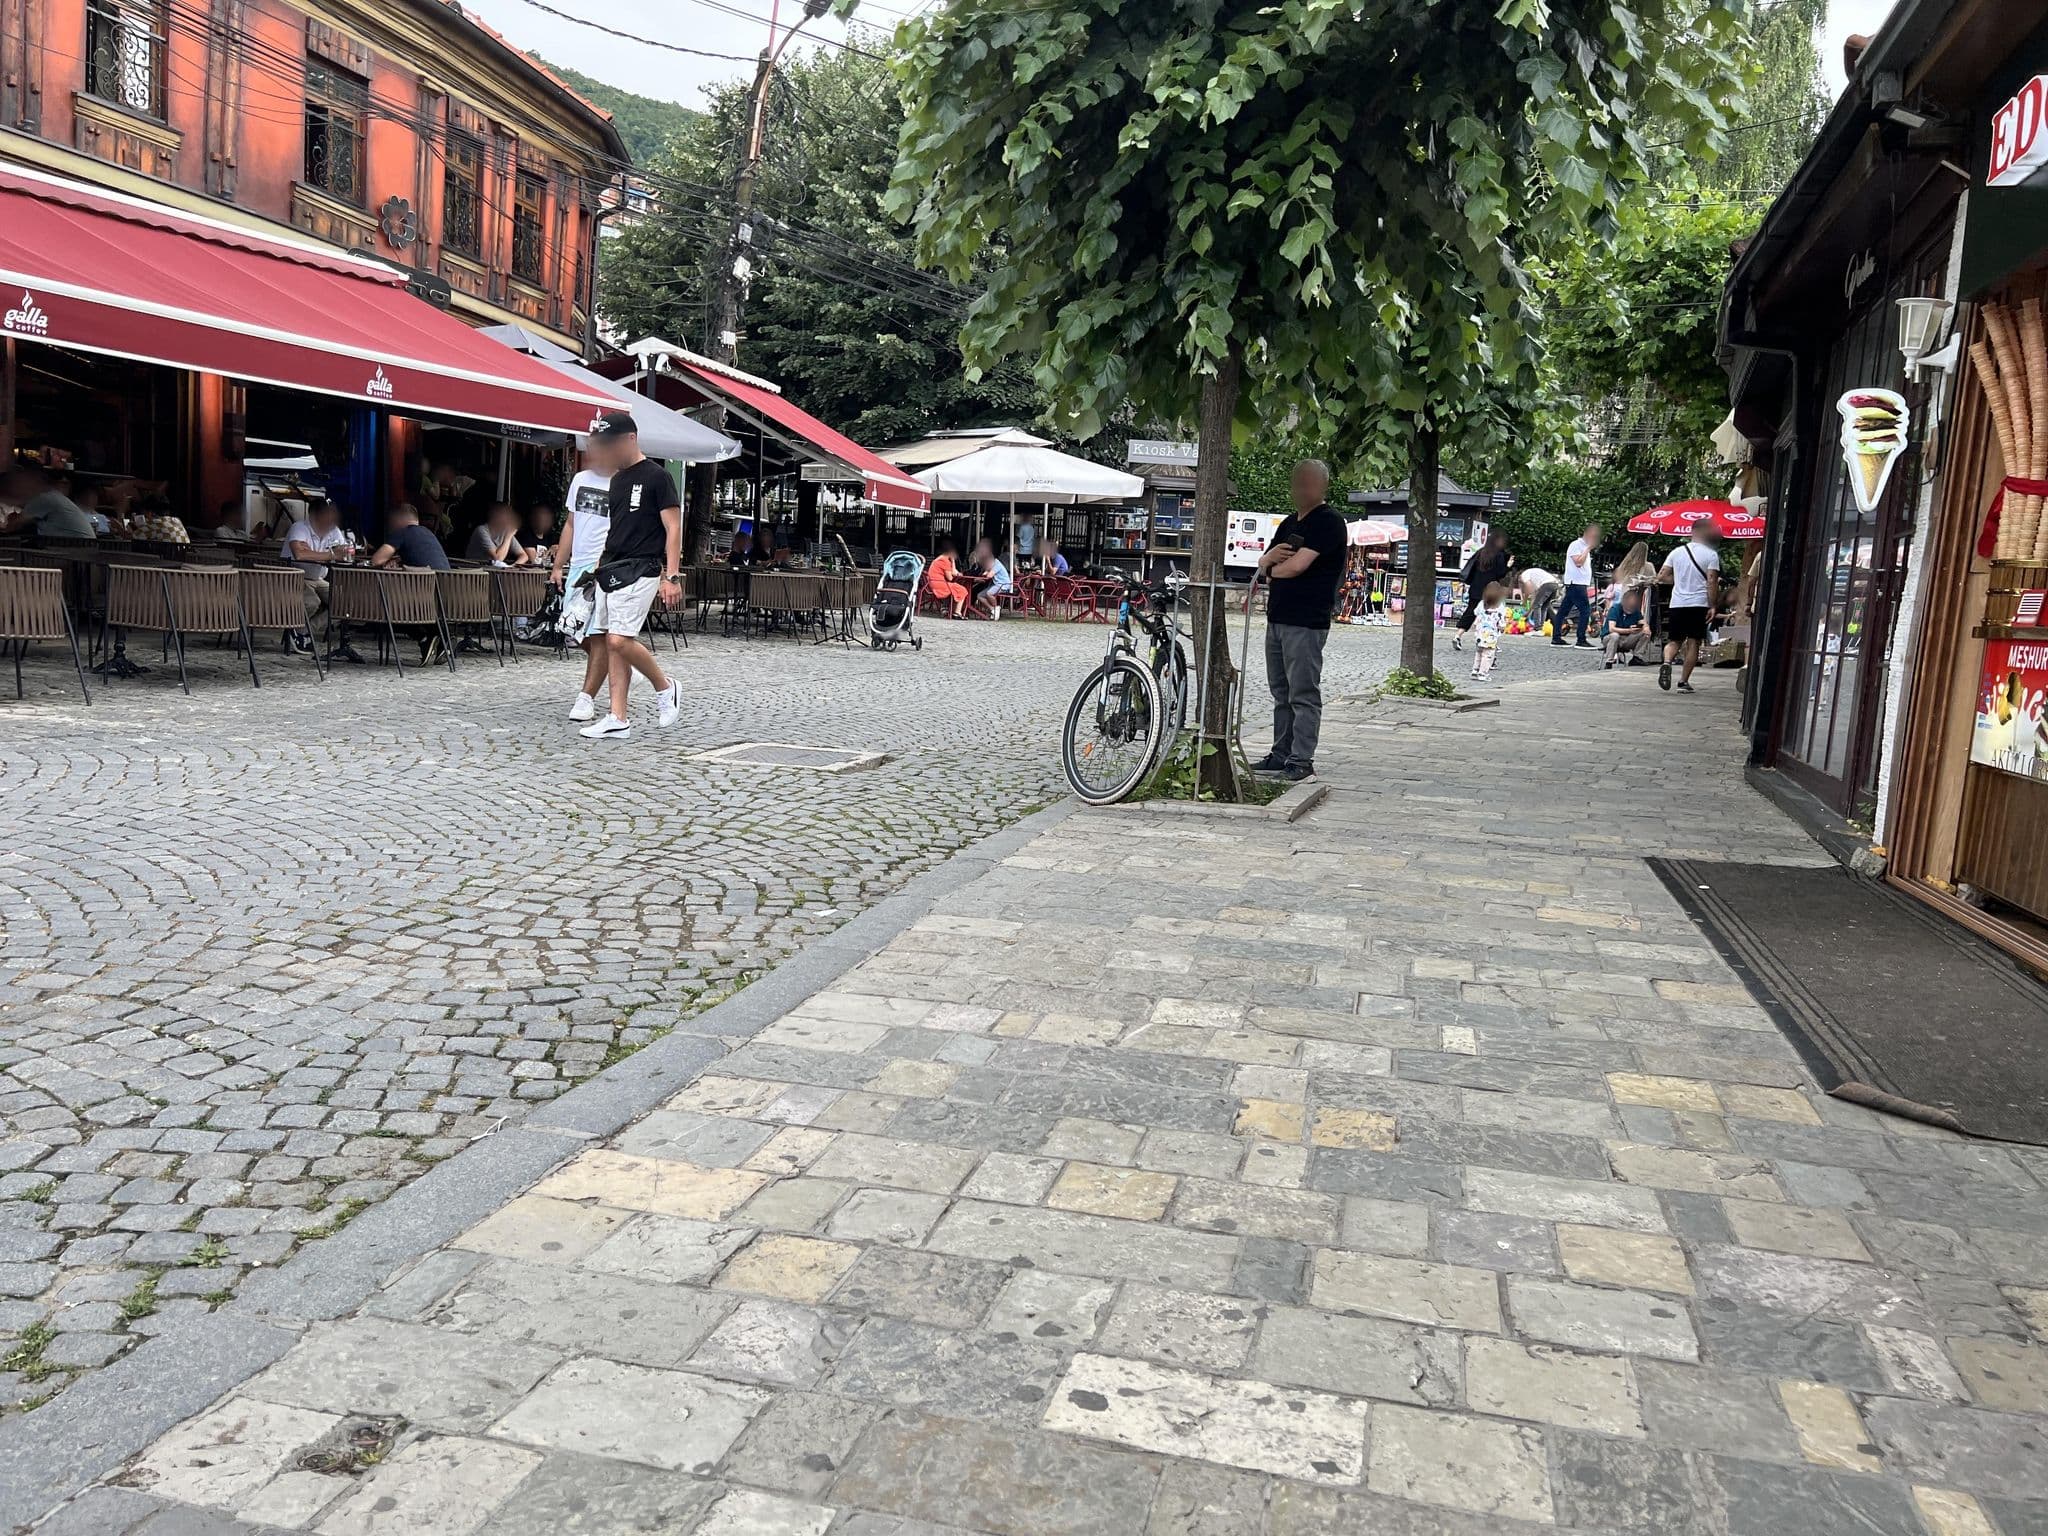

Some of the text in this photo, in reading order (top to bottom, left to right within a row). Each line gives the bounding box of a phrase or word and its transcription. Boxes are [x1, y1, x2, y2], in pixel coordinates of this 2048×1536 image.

[1987, 76, 2048, 184] ED
[4, 307, 48, 329] galla
[15, 324, 47, 336] coffee
[366, 377, 393, 395] galla
[1181, 446, 1199, 458] Va
[630, 484, 643, 507] NIKE
[1673, 525, 1693, 533] ALG
[1731, 528, 1761, 536] ALGIDA
